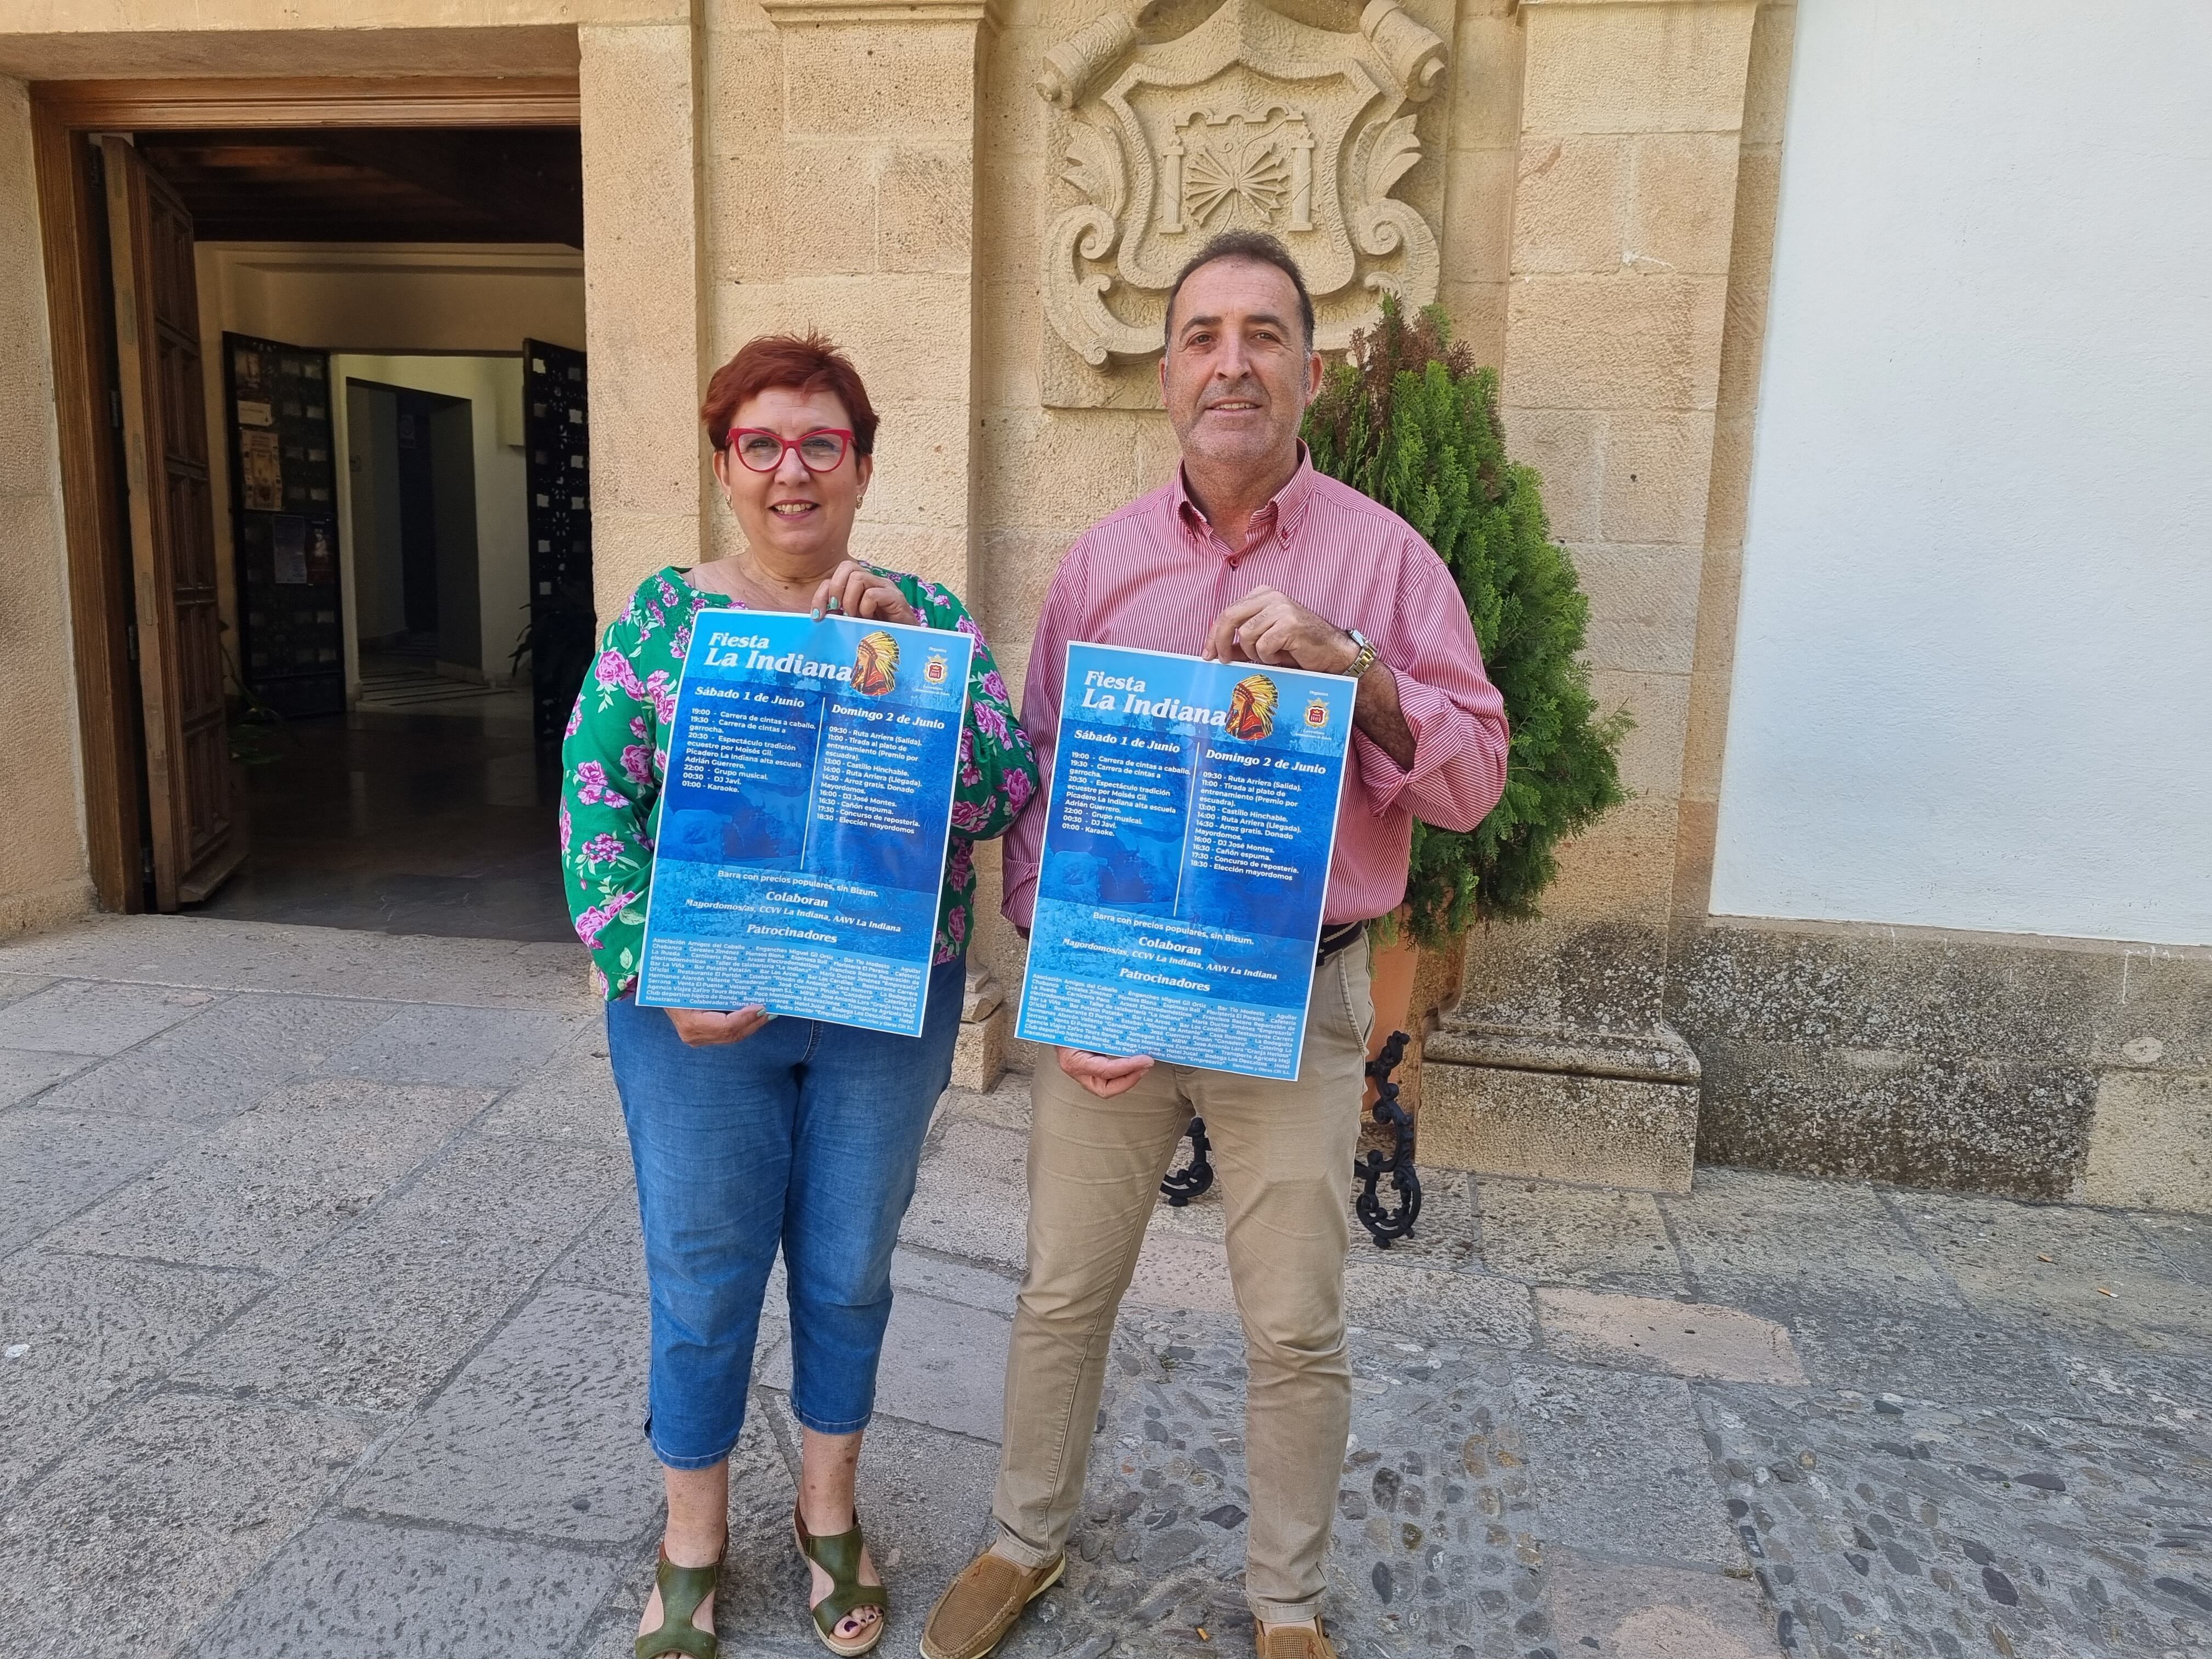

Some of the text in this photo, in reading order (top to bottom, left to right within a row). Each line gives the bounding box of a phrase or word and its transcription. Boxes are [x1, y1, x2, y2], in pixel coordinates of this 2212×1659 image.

[709, 632, 769, 648] Fiesta
[704, 647, 852, 682] La Indiana
[1084, 670, 1146, 692] Fiesta
[695, 686, 804, 707] Sábado 1 de Junio
[832, 704, 945, 729] Domingo 2 de Junio
[1082, 688, 1226, 726] La Indiana
[1074, 730, 1180, 753] Sábado 1 de Junio
[1097, 764, 1122, 772] Carrera
[1134, 769, 1155, 777] cintas
[1098, 755, 1124, 765] Carrera
[1136, 761, 1157, 769] cintas
[1164, 766, 1190, 775] caballo.
[1205, 749, 1326, 774] Domingo 2 de Junio
[1069, 769, 1101, 777] garrocha.
[1067, 785, 1097, 793] ecuestre
[1111, 790, 1135, 799] Moisés
[1068, 775, 1087, 783] 20:30
[1096, 780, 1138, 791] Espectáculo
[1139, 786, 1170, 796] tradición
[1224, 782, 1246, 791] Tirada
[1246, 778, 1271, 786] Arriera
[1273, 781, 1301, 792] (Salida).
[1065, 799, 1121, 812] Adrián Guerrero.
[1066, 791, 1096, 801] Picadero
[1107, 798, 1133, 806] Indiana
[1149, 805, 1176, 813] escuela
[1199, 797, 1235, 807] escuadra).
[1200, 788, 1254, 800] entrenamiento
[1255, 795, 1284, 805] (Premio
[1063, 815, 1082, 823] 00:30
[1091, 811, 1113, 820] Grupo
[1114, 816, 1142, 824] musical.
[1197, 811, 1215, 820] 14:00
[1239, 818, 1265, 827] Arriera
[1266, 822, 1301, 833] (Llegada).
[1198, 803, 1216, 811] 13:00
[1222, 807, 1248, 816] Castillo
[1250, 811, 1288, 822] Hinchable.
[1062, 822, 1080, 831] 01:00
[1085, 826, 1114, 836] Karaoke.
[1195, 827, 1242, 840] Mayordomos.
[1196, 819, 1214, 827] 14:30
[1265, 830, 1293, 839] Donado
[1193, 843, 1210, 851] 16:30
[1216, 848, 1239, 856] Cañón
[1240, 852, 1271, 861] espuma.
[1194, 836, 1211, 844] 16:00
[1246, 844, 1274, 853] Montes.
[1190, 859, 1207, 867] 18:30
[1214, 864, 1244, 873] Elección
[1245, 869, 1293, 881] mayordomos
[1214, 855, 1248, 866] Concurso
[1261, 863, 1299, 873] repostería.
[718, 870, 741, 878] Barra
[792, 878, 834, 891] populares,
[850, 887, 878, 897] Bizum.
[766, 891, 828, 907] Colaboran
[685, 899, 756, 912] Mayordomos/as,
[797, 911, 831, 921] Indiana,
[833, 916, 855, 924] AAVV
[868, 921, 901, 932] Indiana
[747, 924, 837, 943] Patrocinadores
[1093, 912, 1115, 922] Barra
[1133, 920, 1164, 929] precios
[1165, 926, 1208, 938] populares,
[1225, 934, 1254, 945] Bizum.
[1138, 936, 1201, 955] Colaboran
[1063, 938, 1128, 956] Mayordomos/as,
[1132, 951, 1155, 960] CCVV
[1169, 957, 1203, 969] Indiana,
[1206, 963, 1229, 972] AAVV
[1243, 969, 1277, 979] Indiana
[1032, 974, 1062, 982] Asociación
[1128, 991, 1159, 1000] Enganches
[1119, 968, 1210, 991] Patrocinadores
